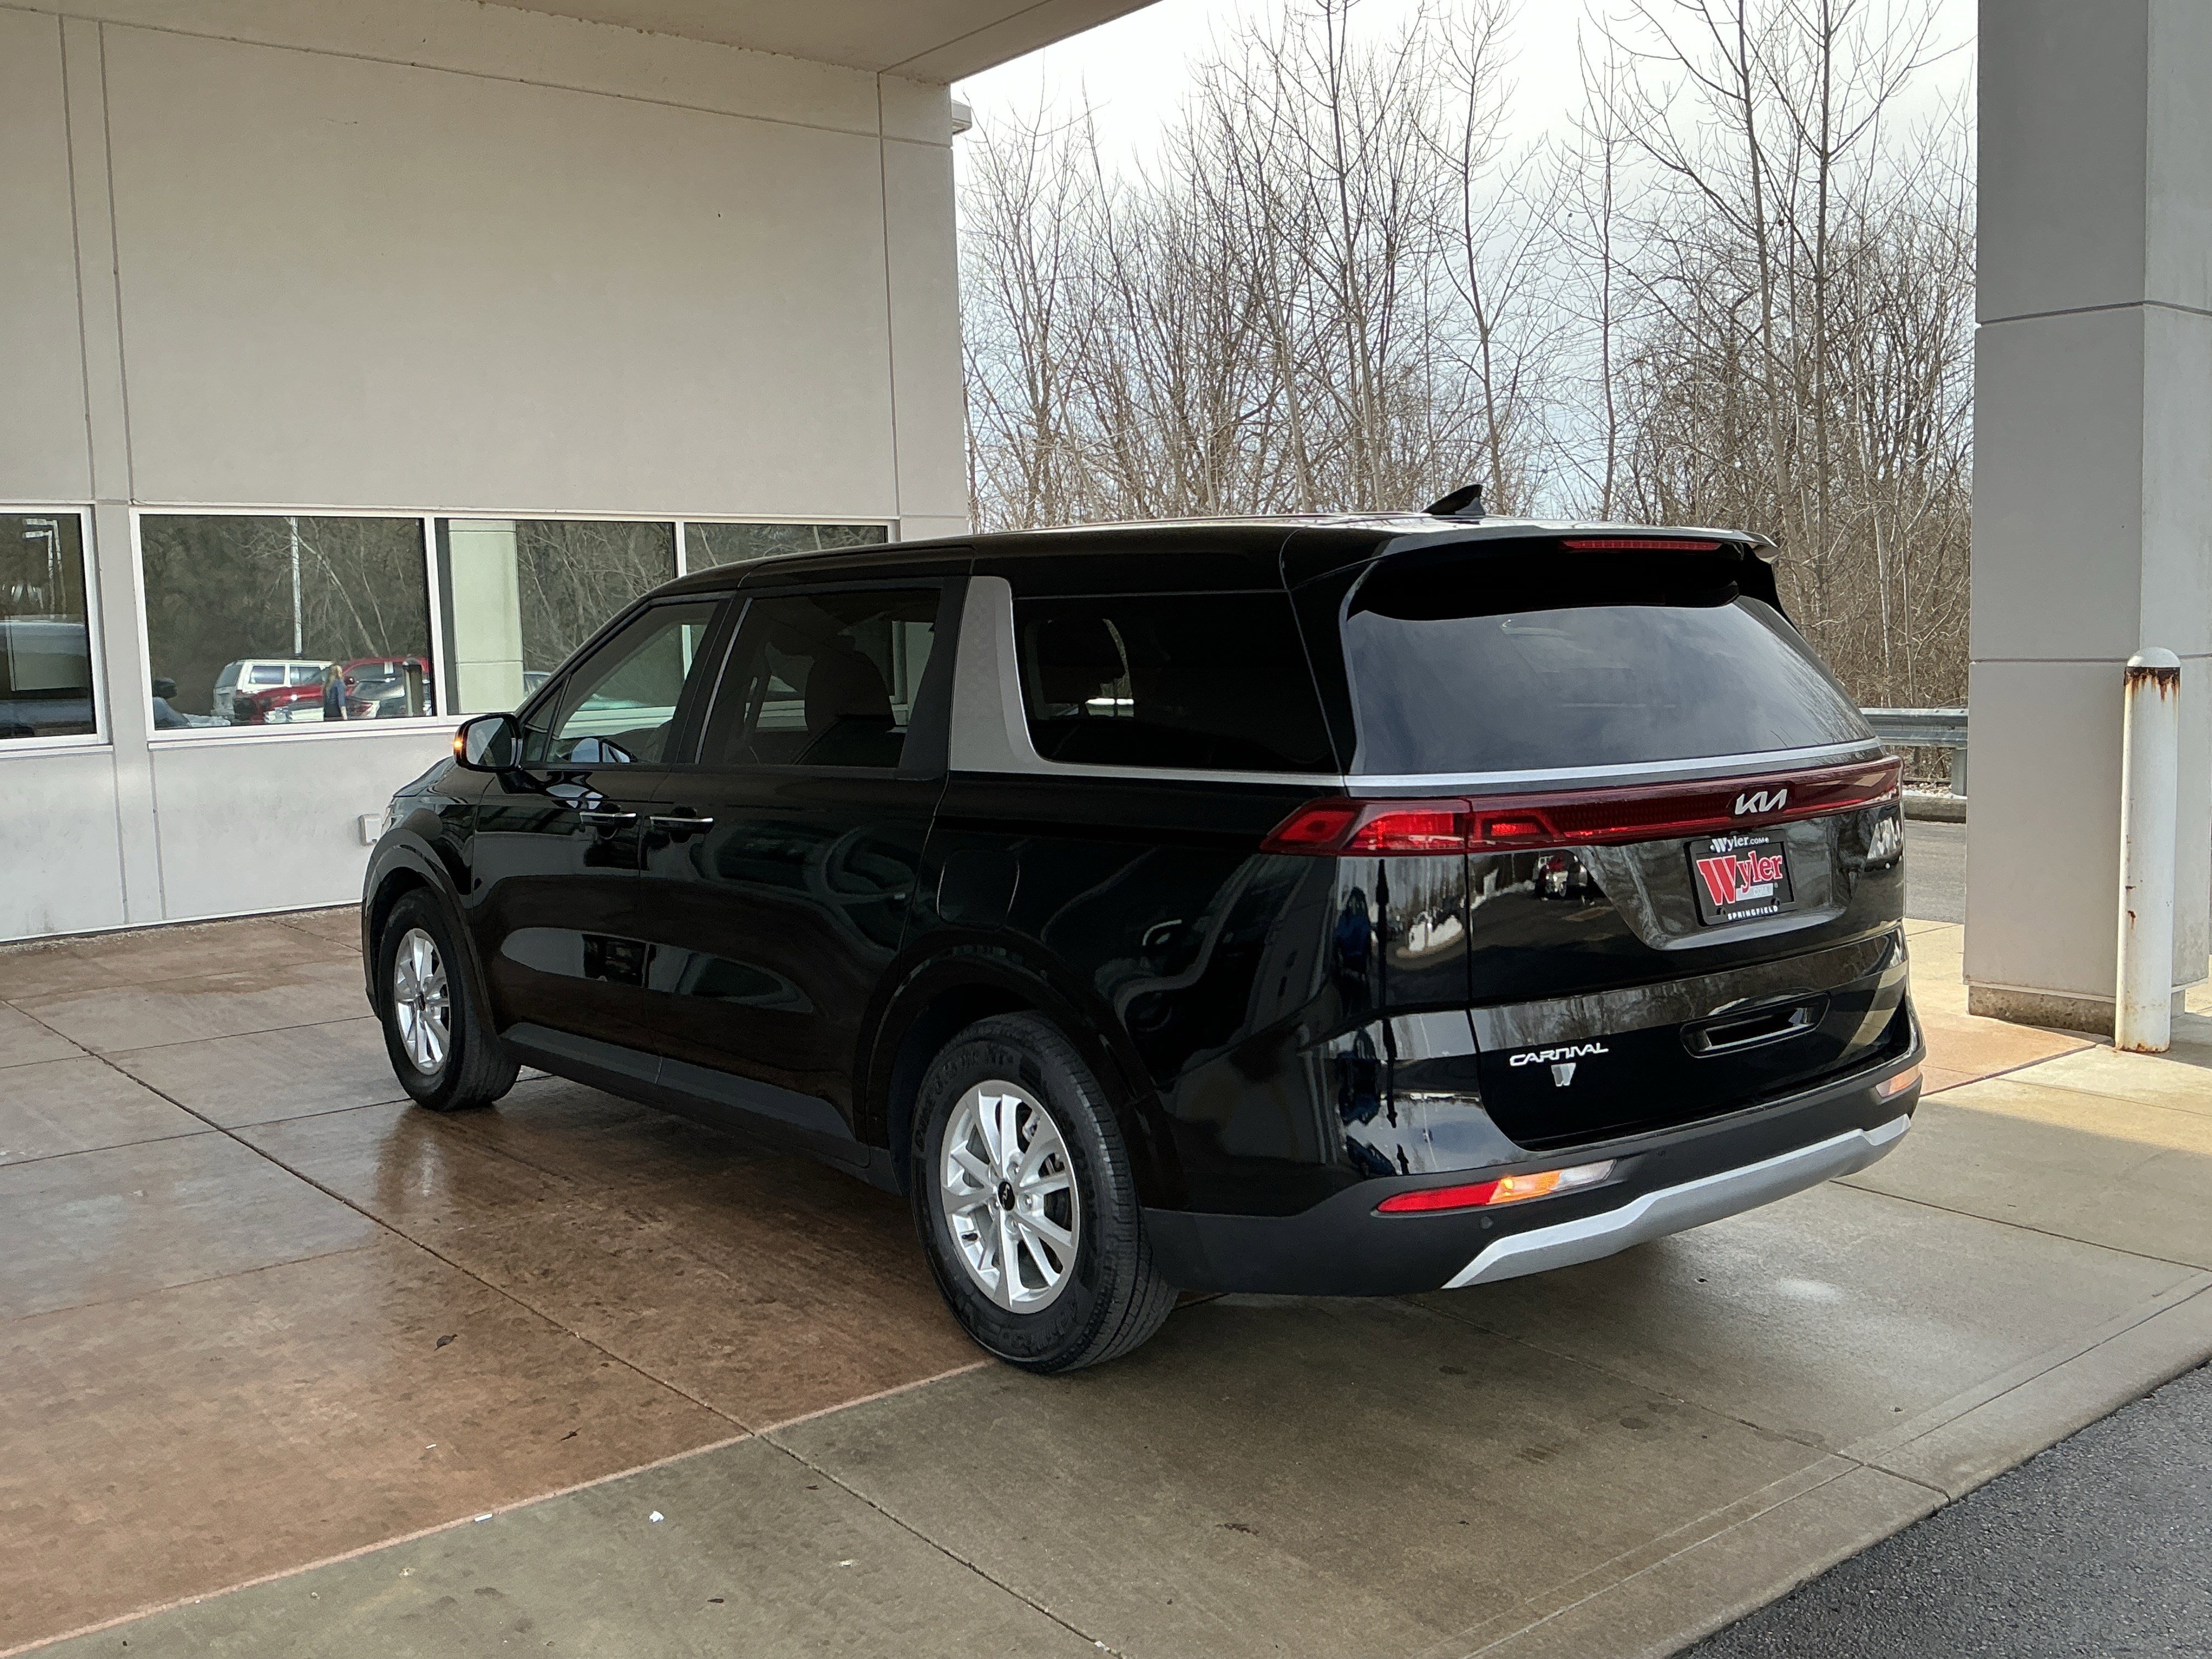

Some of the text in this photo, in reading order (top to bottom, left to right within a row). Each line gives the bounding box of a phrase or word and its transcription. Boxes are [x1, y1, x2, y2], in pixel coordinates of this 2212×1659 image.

[1735, 789, 1787, 815] KIA
[1696, 850, 1783, 905] Wyler
[1728, 906, 1778, 920] SPRINGFIELD
[1509, 1042, 1609, 1066] CARNIVAL
